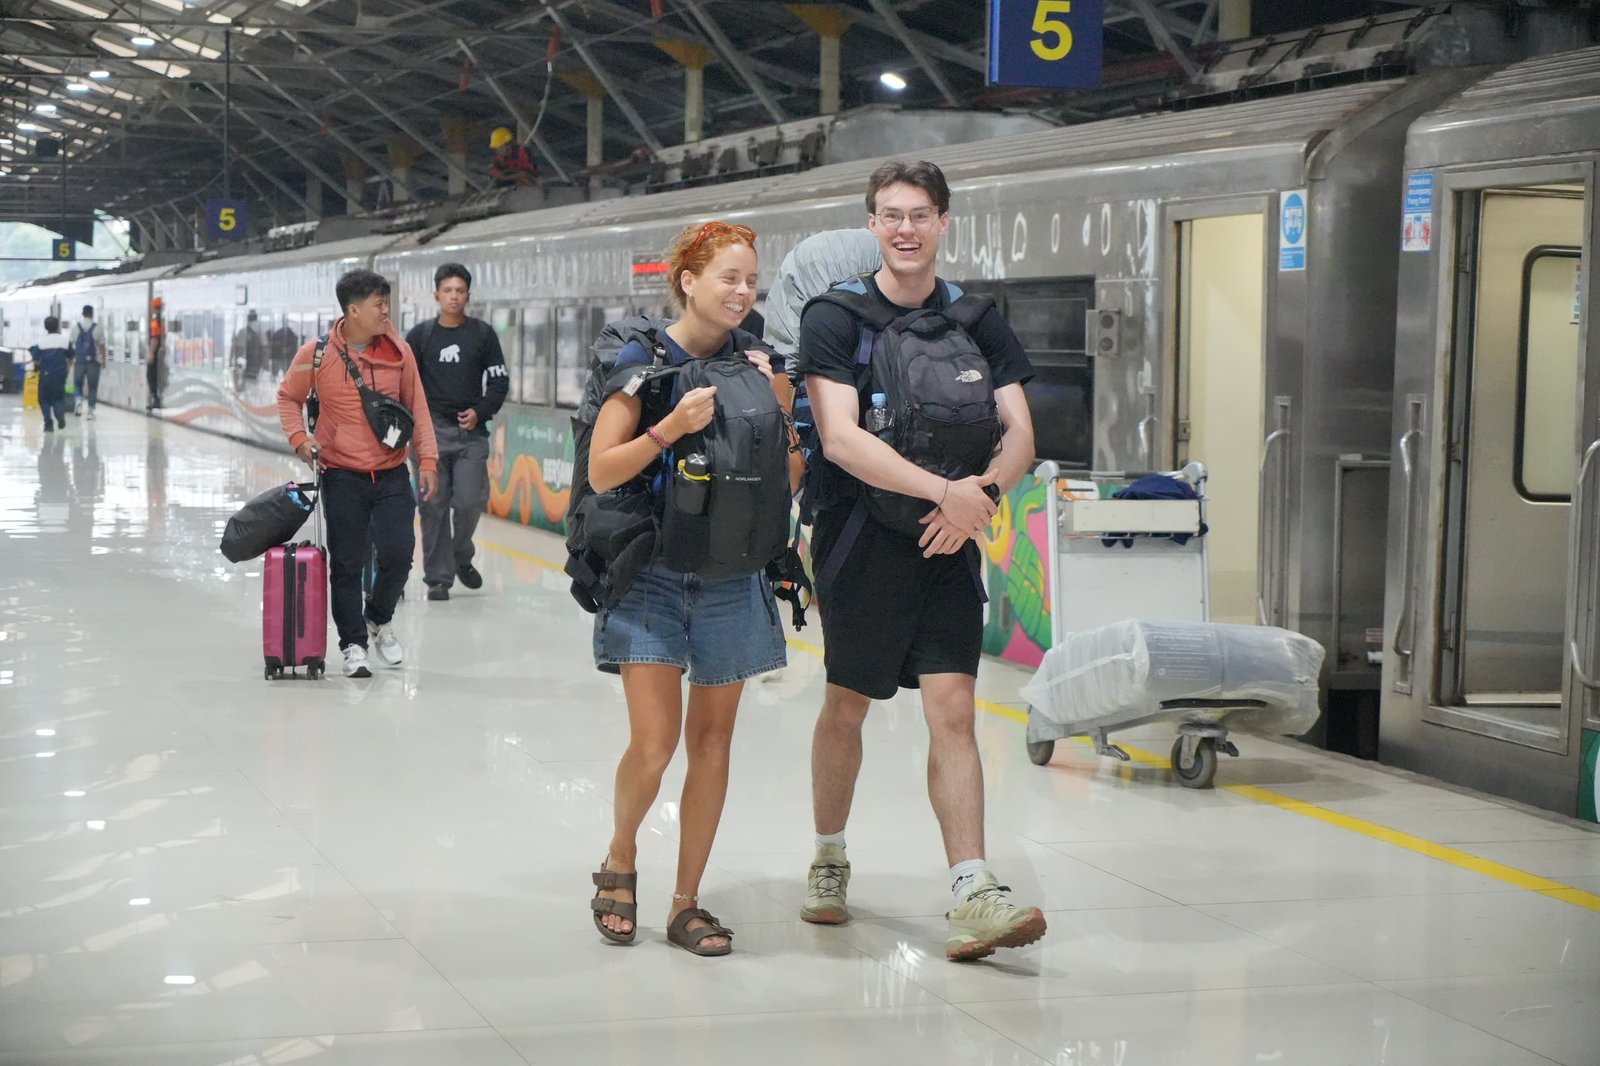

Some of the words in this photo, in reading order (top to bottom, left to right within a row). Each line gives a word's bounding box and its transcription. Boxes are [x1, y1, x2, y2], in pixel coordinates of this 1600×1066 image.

[1029, 0, 1073, 61] 5
[218, 207, 237, 231] 5
[58, 243, 70, 257] 5
